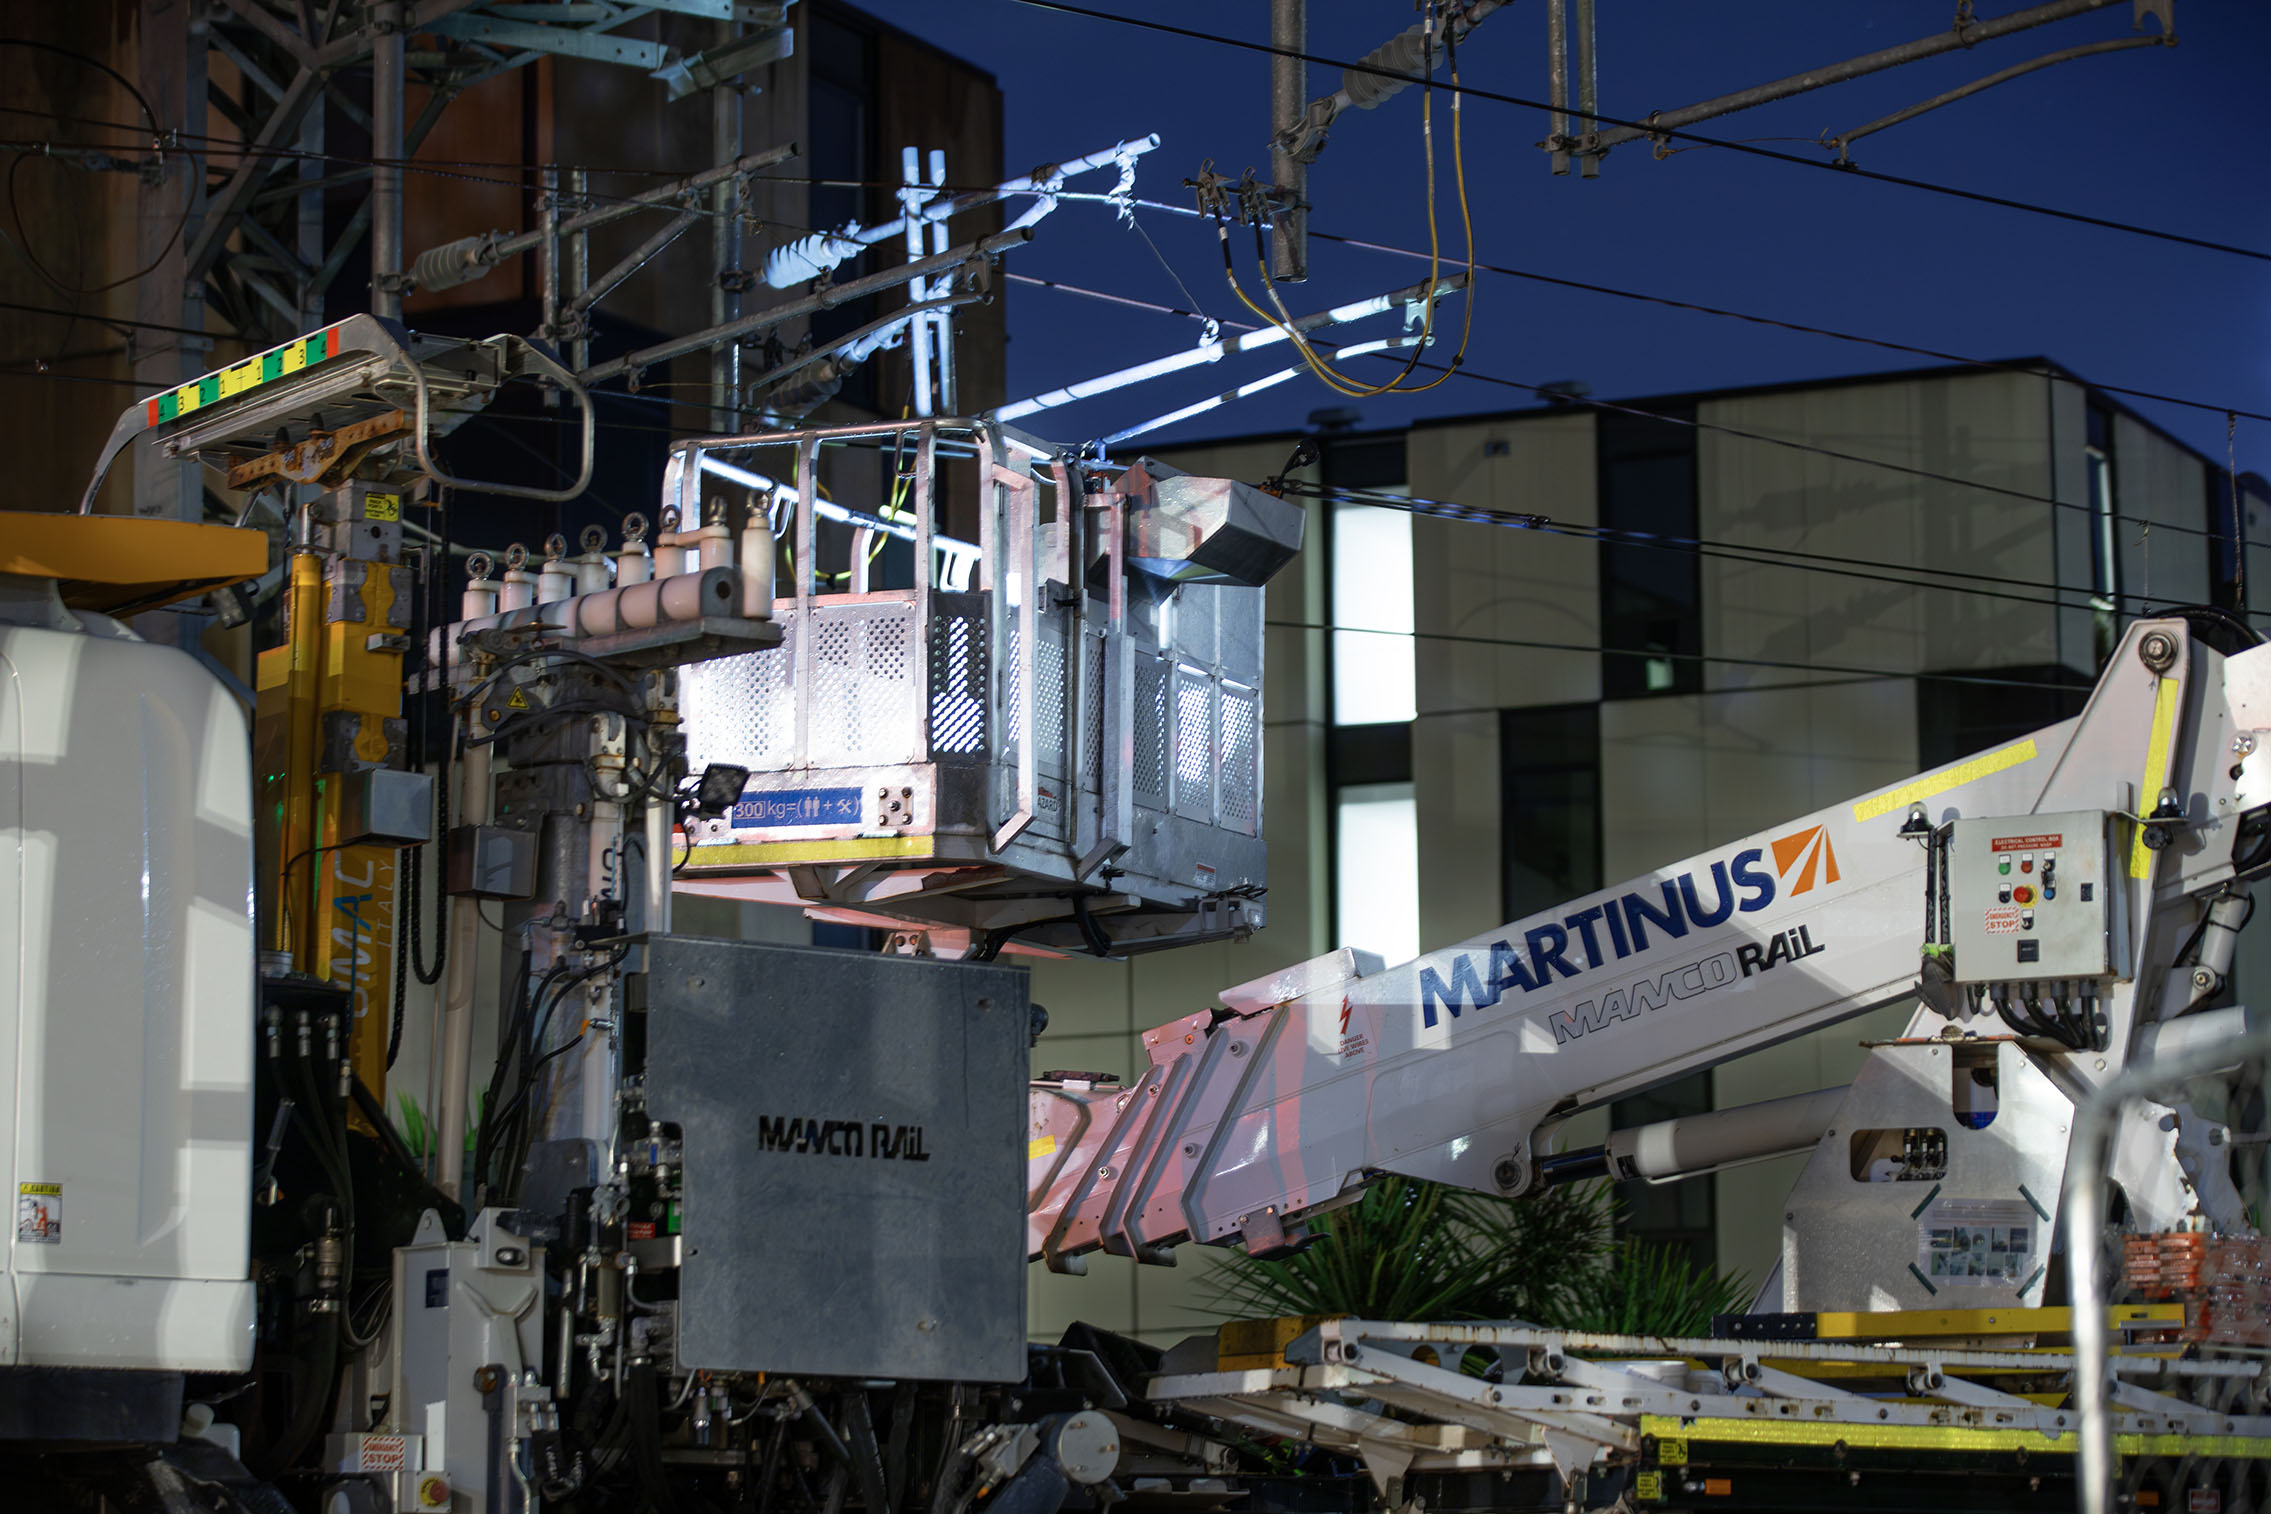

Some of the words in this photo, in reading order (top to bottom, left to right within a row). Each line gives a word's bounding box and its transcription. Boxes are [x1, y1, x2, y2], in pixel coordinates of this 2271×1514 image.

[735, 803, 763, 818] 300
[377, 859, 395, 949] ITALY
[1990, 920, 2016, 928] STOP
[1419, 849, 1777, 1029] MARTINUS
[1549, 951, 1737, 1045] MANCO
[1340, 1033, 1363, 1046] DANGER
[1350, 1039, 1368, 1049] WIRES
[1344, 1047, 1364, 1057] ABOVE
[368, 1453, 399, 1464] STOP
